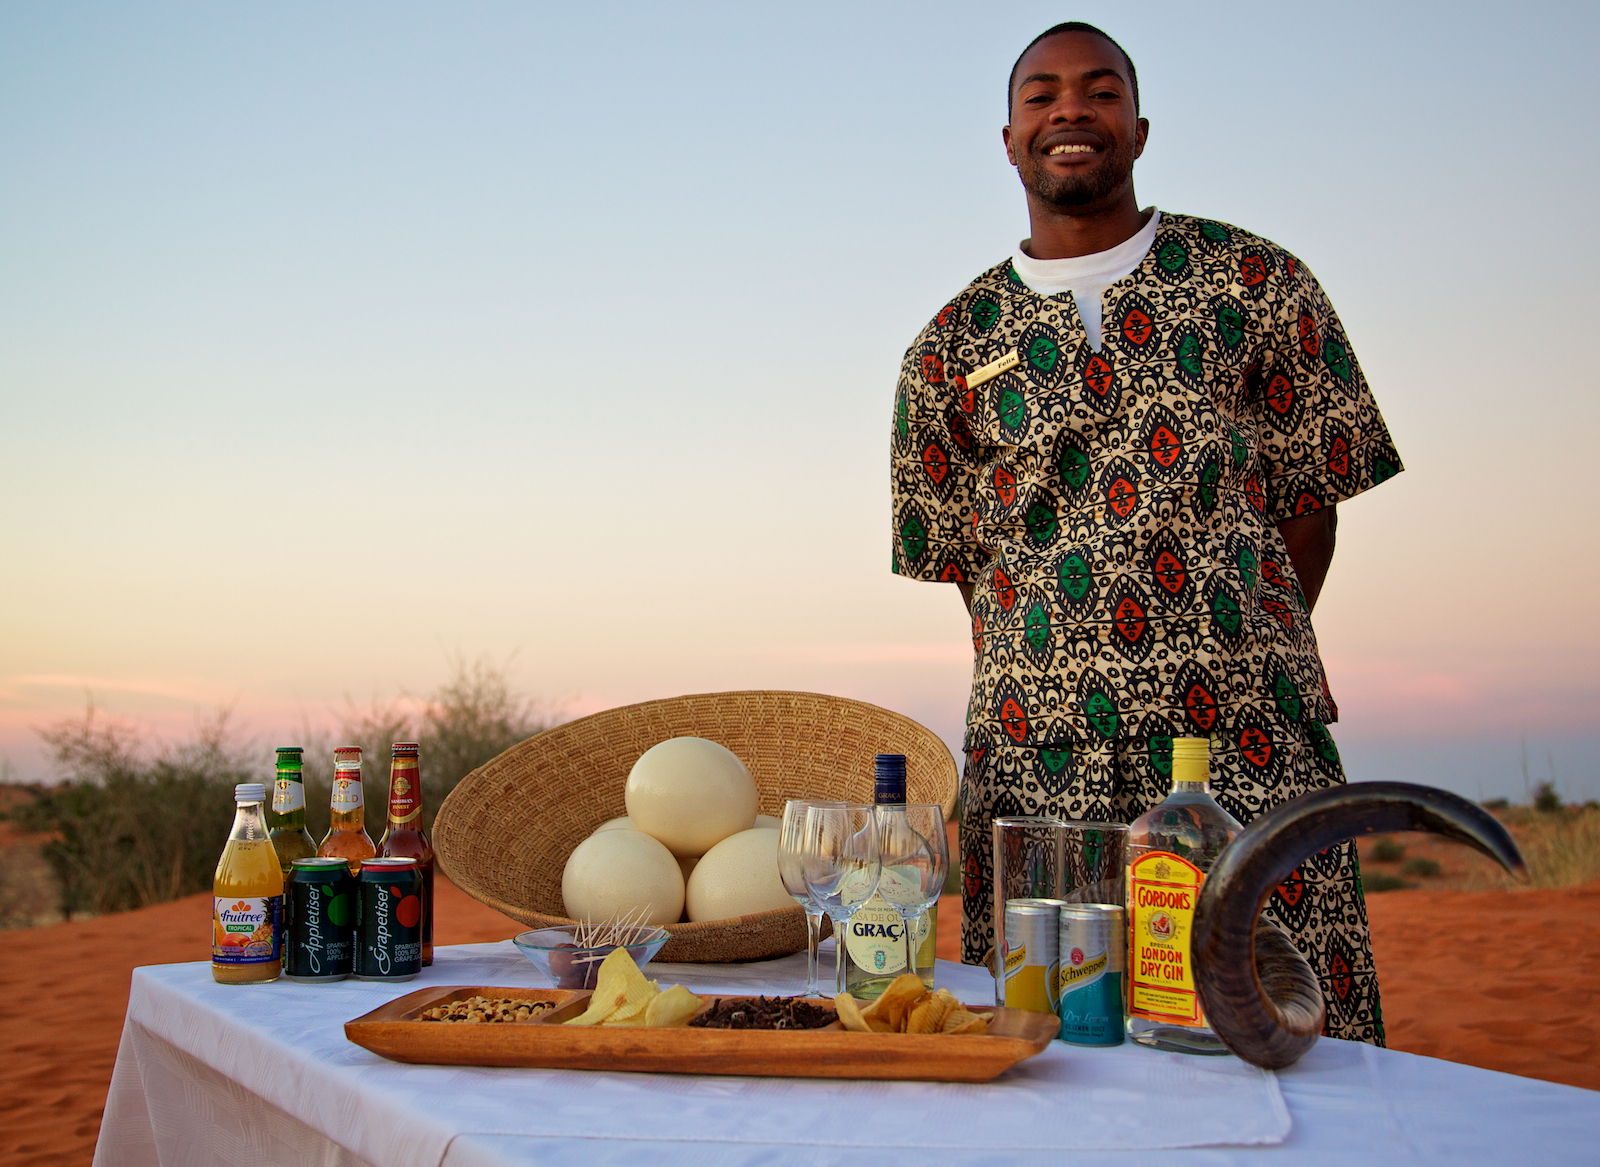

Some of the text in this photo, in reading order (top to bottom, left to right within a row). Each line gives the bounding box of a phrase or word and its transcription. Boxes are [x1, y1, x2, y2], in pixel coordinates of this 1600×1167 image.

[998, 356, 1016, 369] Felix
[274, 794, 294, 804] DRY
[332, 794, 359, 803] GOLD
[878, 792, 901, 800] GRAÇA
[1138, 886, 1191, 910] GORDON'S
[221, 909, 263, 922] fruitree
[851, 912, 869, 921] ASA
[871, 913, 884, 922] DE
[304, 884, 324, 974] Appletiser
[373, 885, 393, 975] Grapetiser
[326, 954, 343, 962] APPLE
[394, 949, 409, 957] 100%
[394, 955, 413, 963] GRAPE
[1141, 946, 1183, 964] LONDON
[1060, 960, 1105, 987] Schweppes
[1140, 960, 1184, 982] DRY GIN
[1063, 1009, 1109, 1025] Dry Lemon
[1072, 1024, 1089, 1032] LEMON
[1091, 1025, 1105, 1033] JUICE
